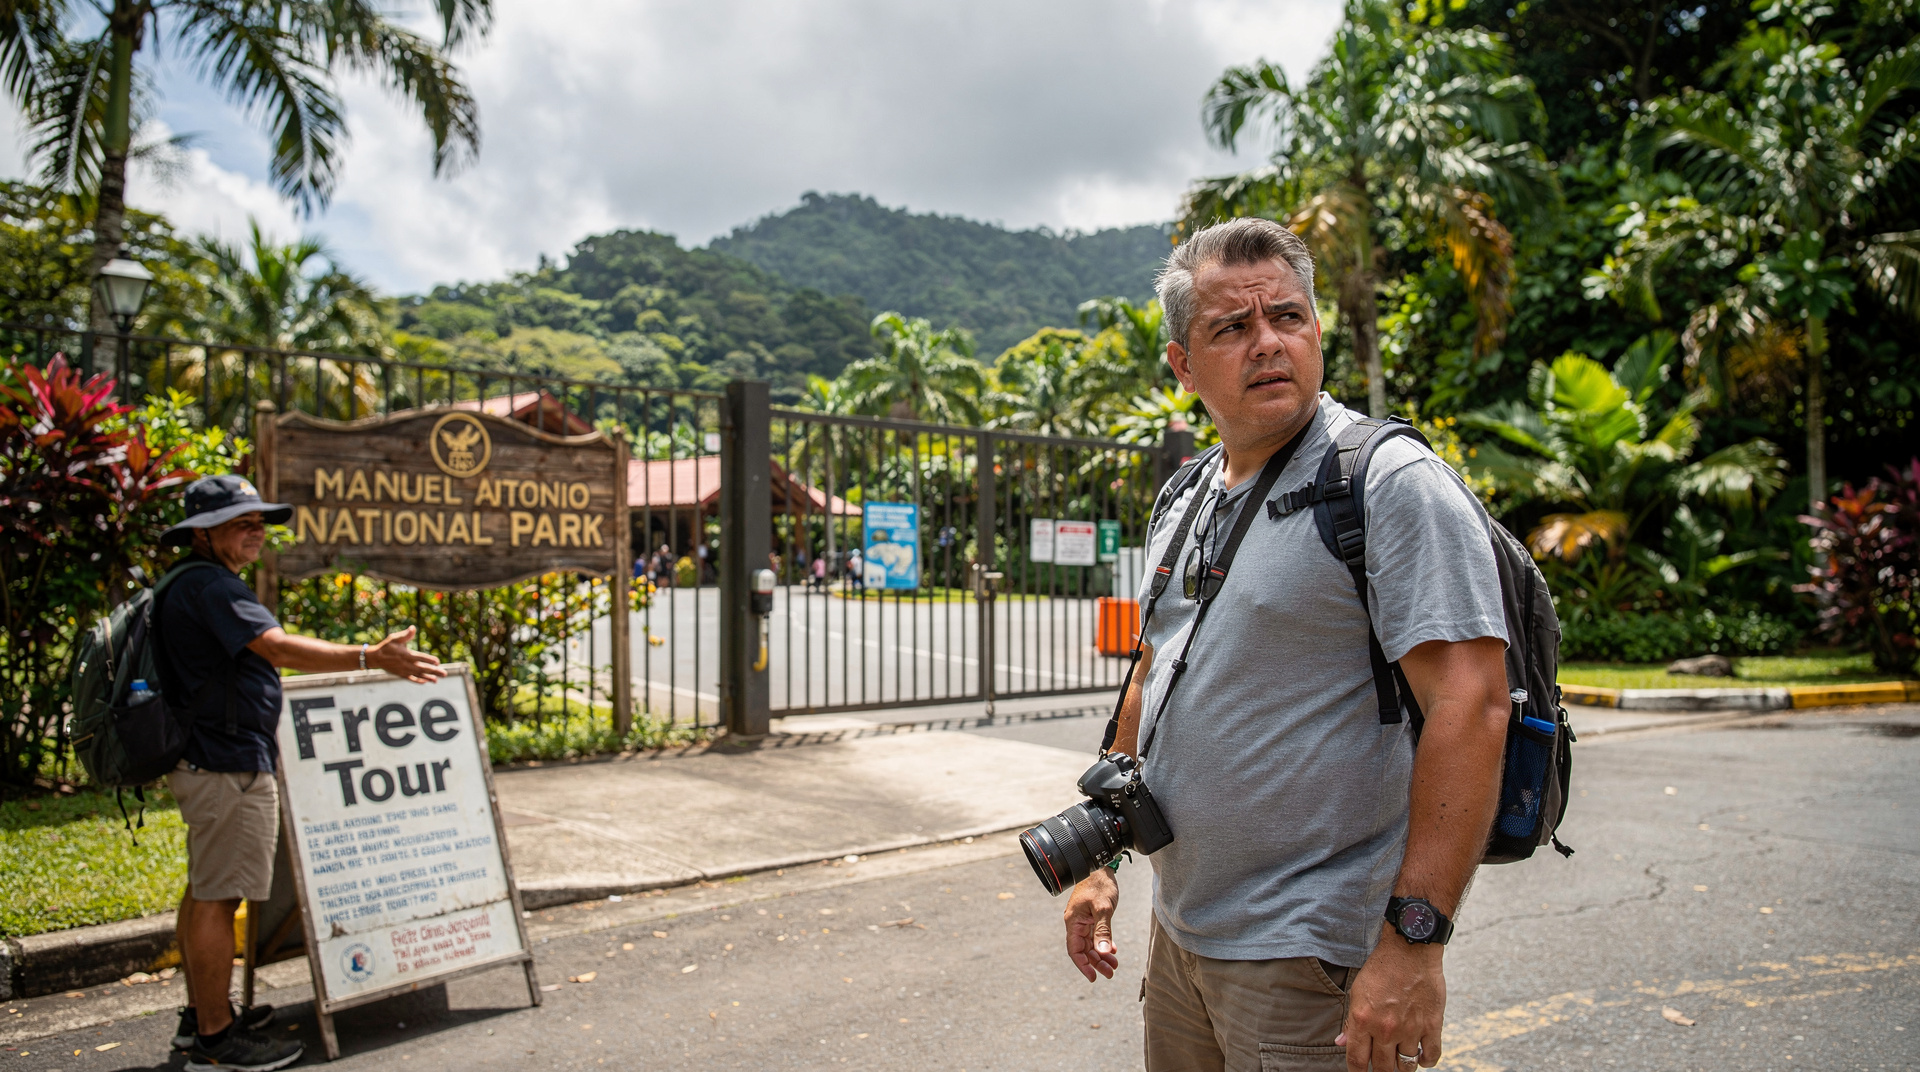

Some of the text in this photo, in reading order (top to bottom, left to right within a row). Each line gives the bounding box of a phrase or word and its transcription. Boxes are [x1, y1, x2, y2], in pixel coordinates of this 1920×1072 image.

[314, 467, 463, 506] MANUEL
[296, 506, 605, 548] NATIONAL PARK
[289, 695, 460, 760] Free
[324, 757, 452, 808] Tour
